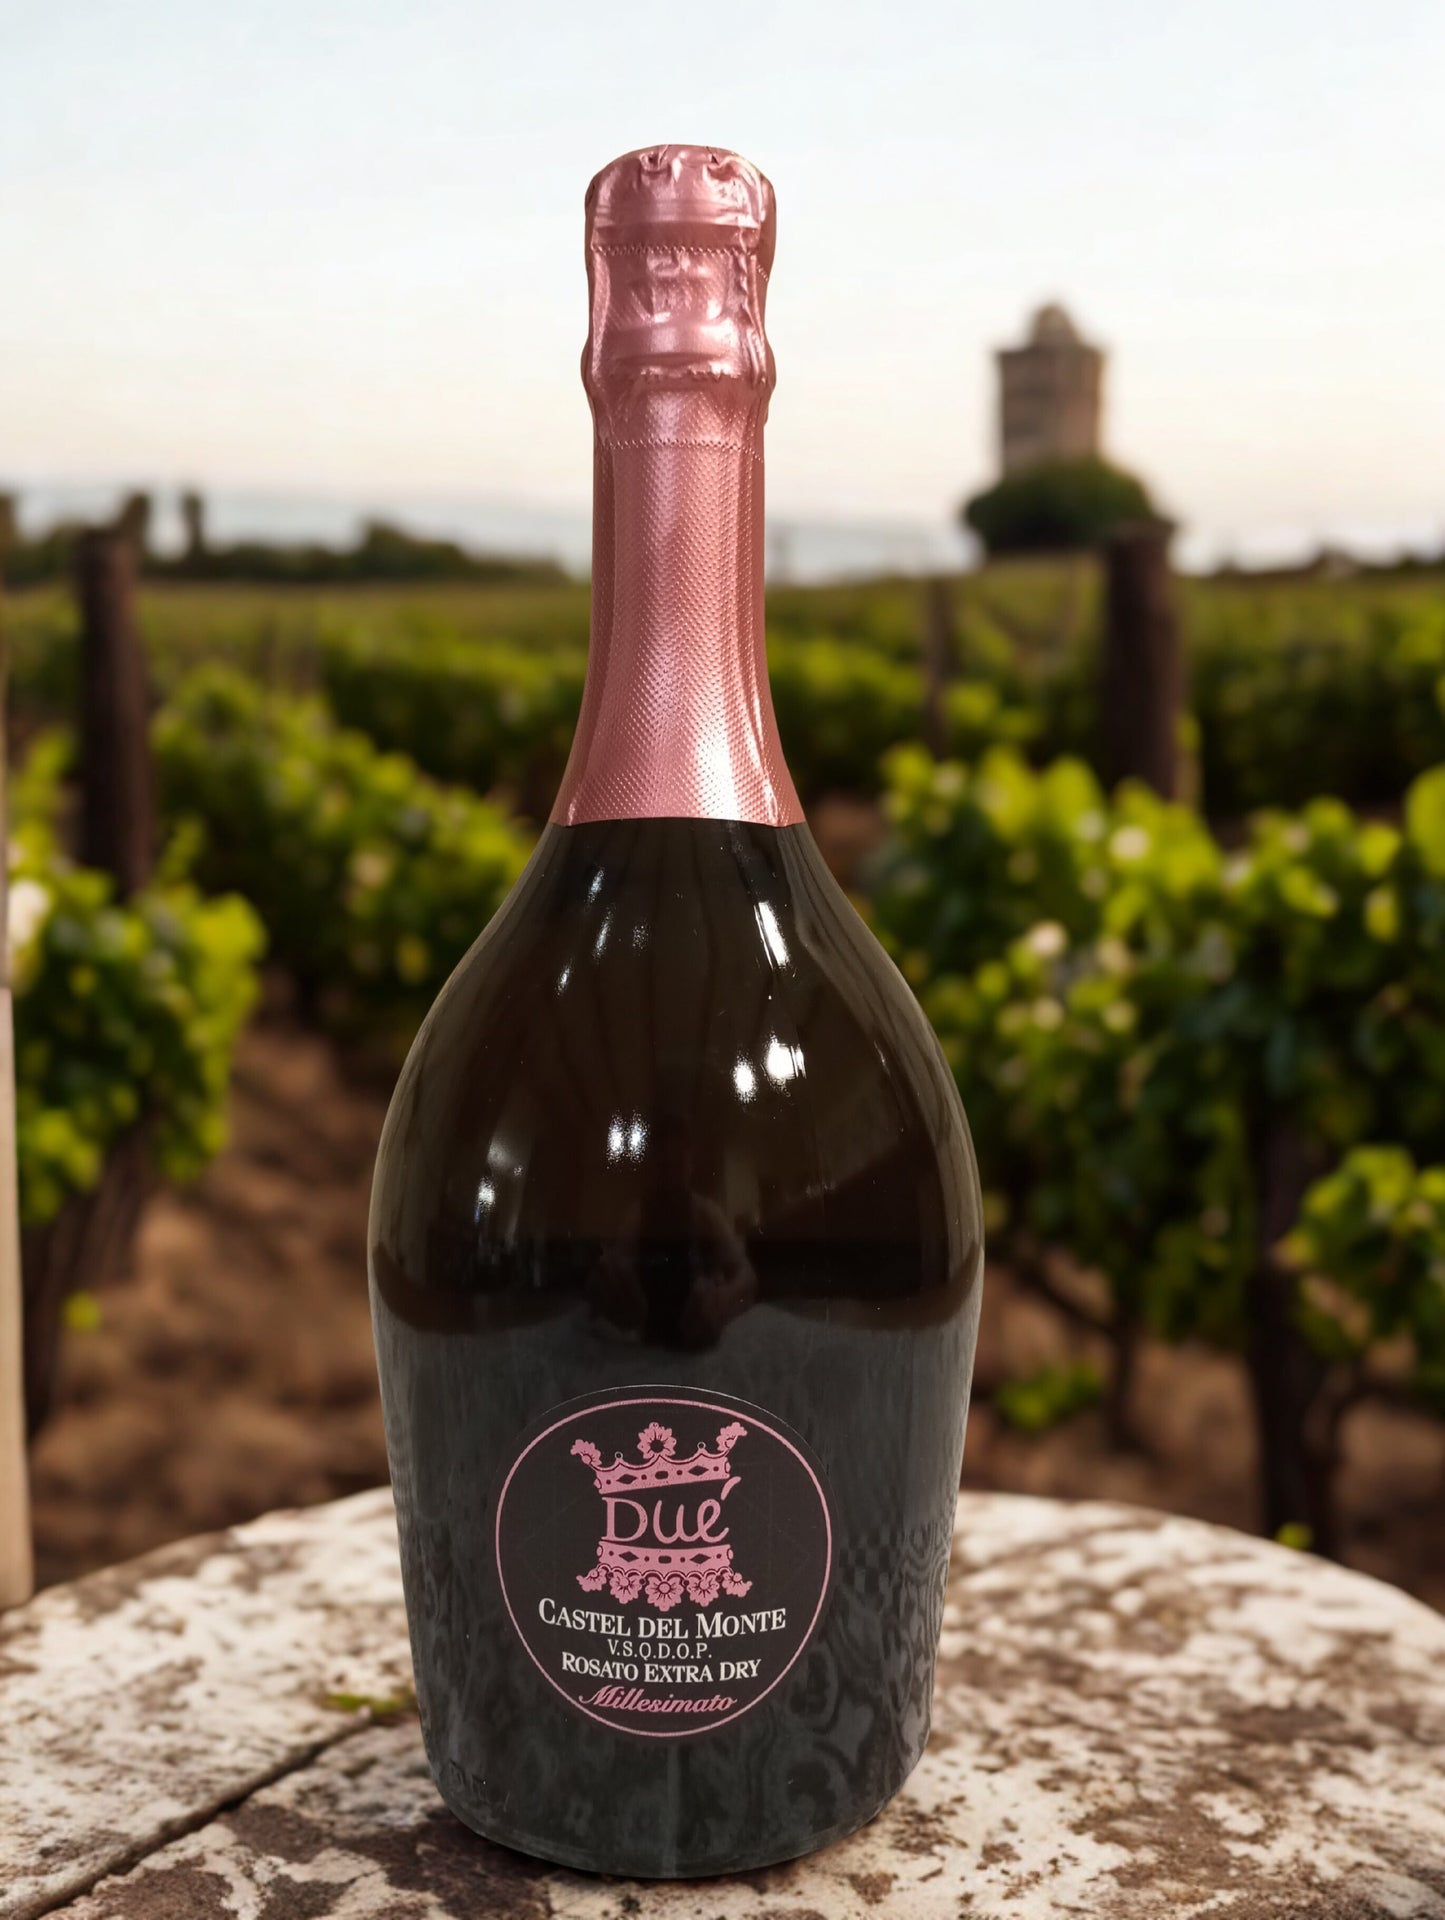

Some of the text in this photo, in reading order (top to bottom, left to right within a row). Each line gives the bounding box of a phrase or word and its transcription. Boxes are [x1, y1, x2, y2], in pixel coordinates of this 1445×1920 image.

[538, 1598, 787, 1639] CASTEL DEL MONTE
[607, 1639, 712, 1660] V.S.Q.D.O.P.
[561, 1651, 762, 1683] ROSATO EXTRA DRY
[578, 1685, 738, 1713] Millesimato
